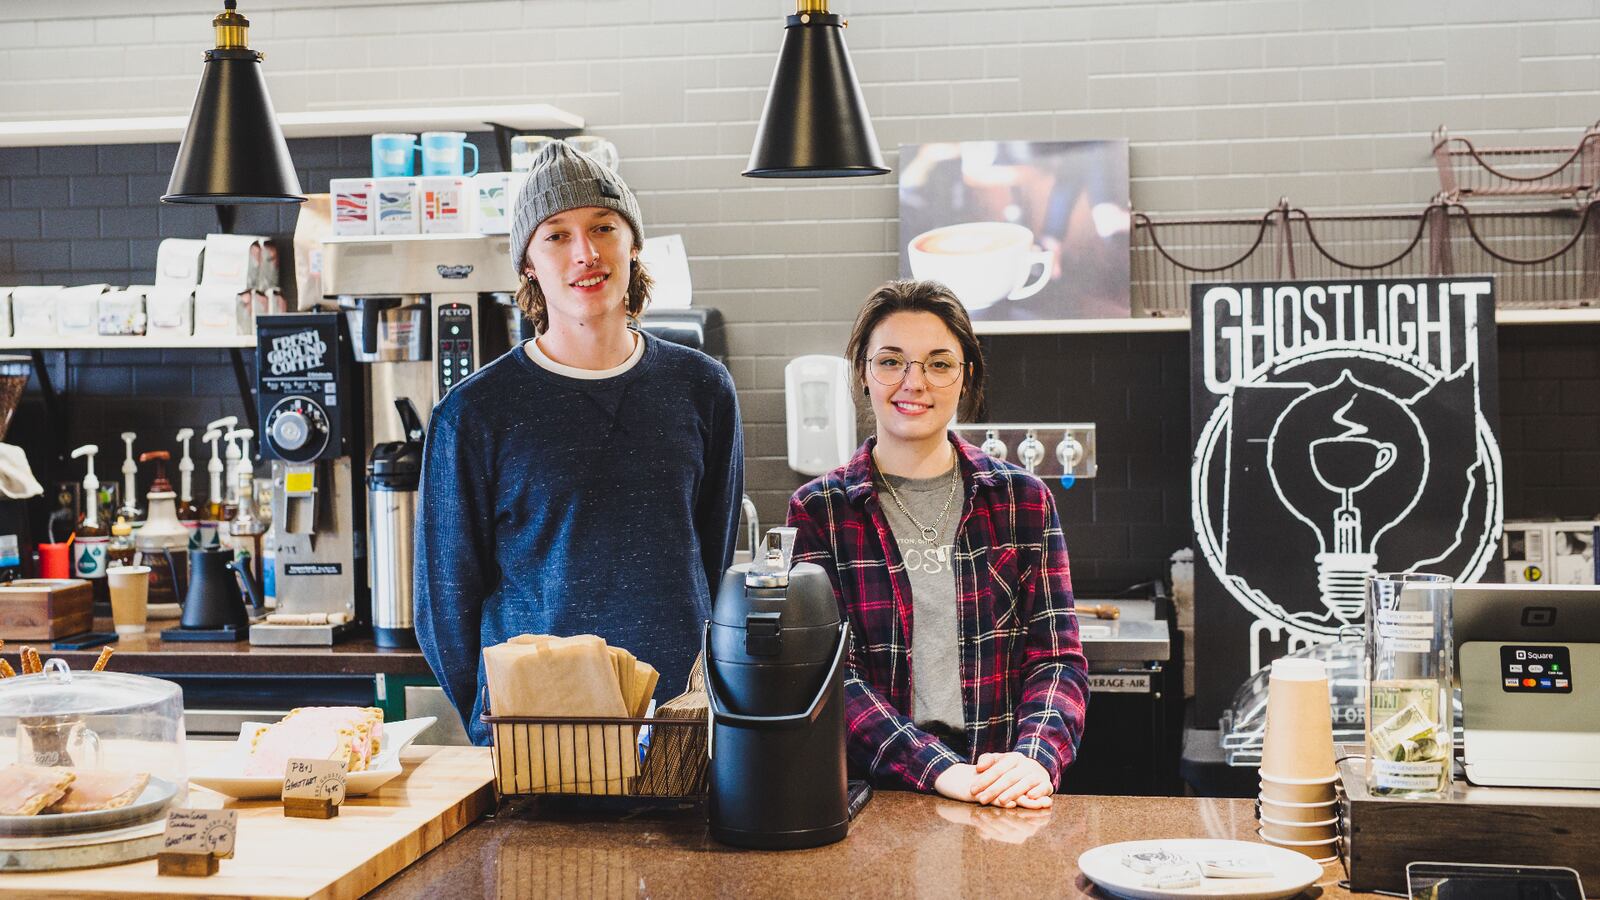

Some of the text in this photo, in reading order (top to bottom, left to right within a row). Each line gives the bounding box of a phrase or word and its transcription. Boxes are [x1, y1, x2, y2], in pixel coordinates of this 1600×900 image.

[272, 330, 321, 352] FRESH
[1203, 282, 1491, 395] GHOSTLIGHT
[267, 341, 327, 364] GROUND
[271, 354, 324, 376] COFFEE
[1527, 652, 1554, 661] Square
